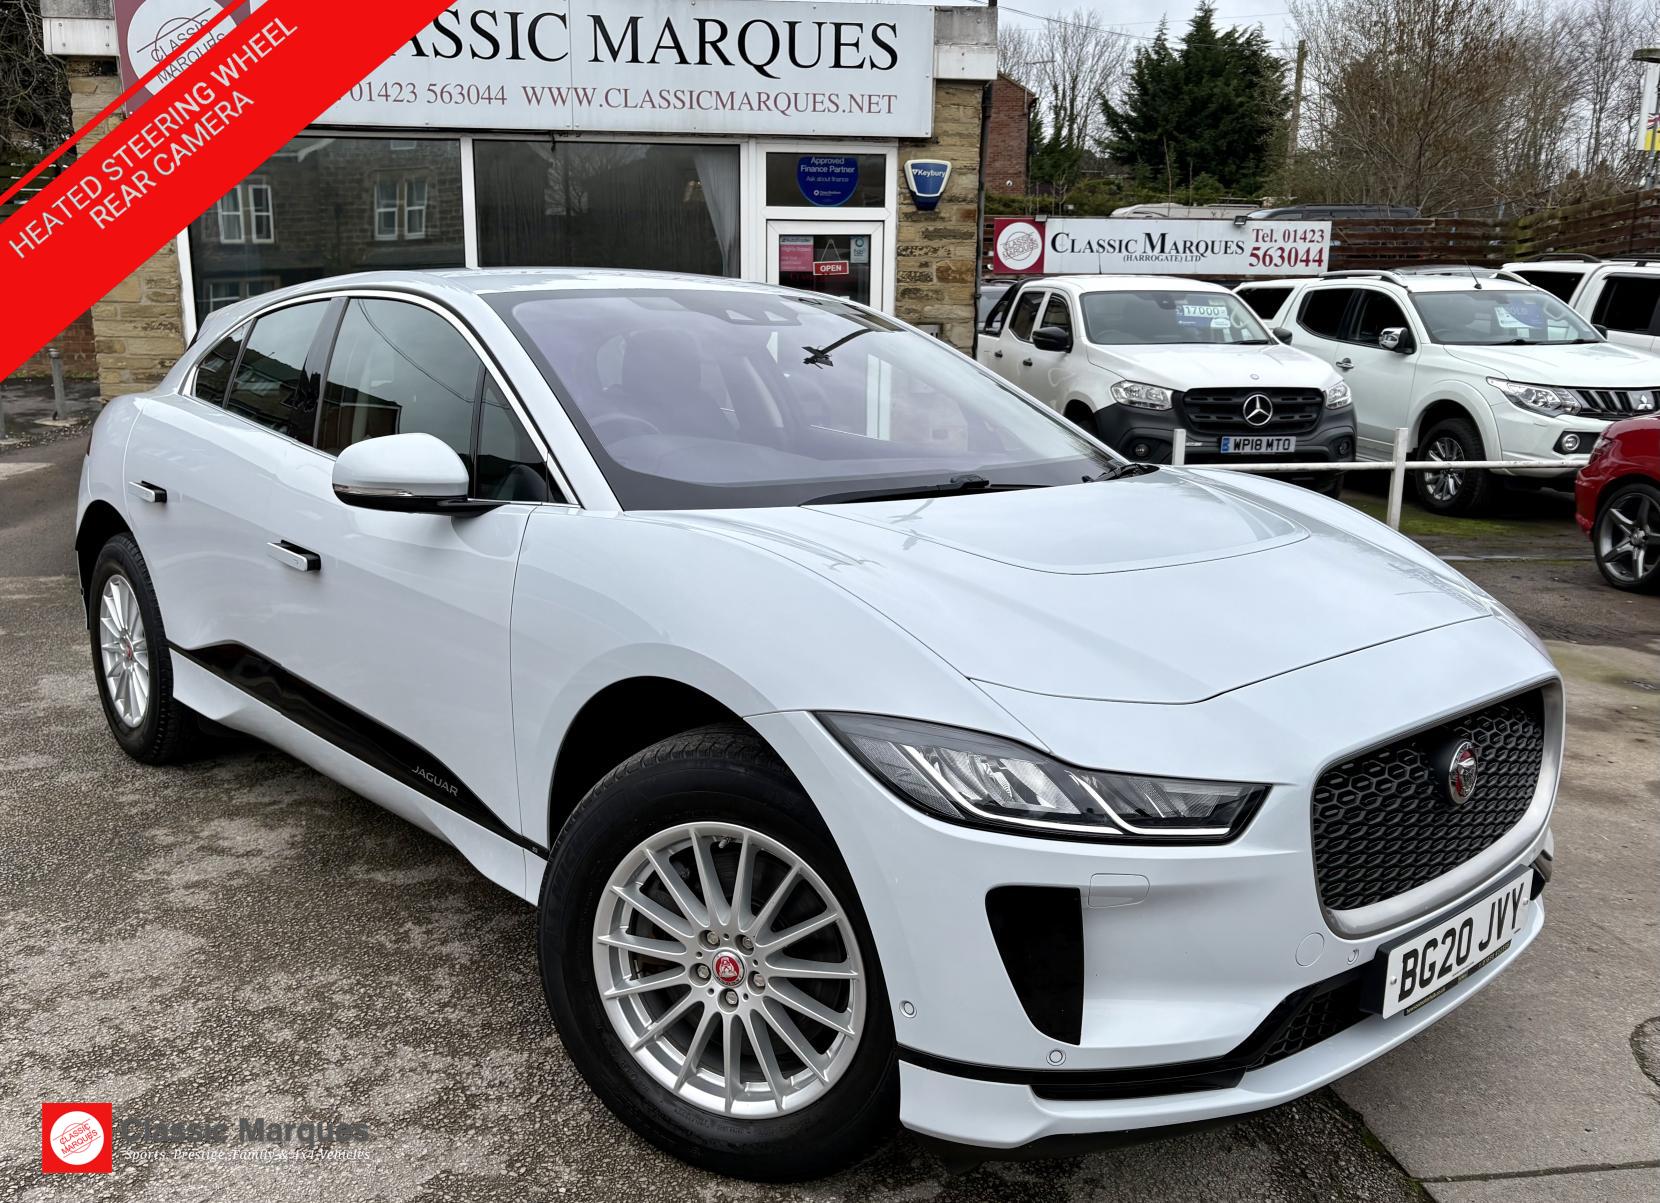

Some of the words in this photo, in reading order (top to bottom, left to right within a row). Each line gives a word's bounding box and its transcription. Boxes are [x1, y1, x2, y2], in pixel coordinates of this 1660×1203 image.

[587, 15, 898, 80] MARQUES
[350, 81, 418, 104] 01423
[426, 83, 508, 106] 563044
[521, 85, 898, 117] WWW.CLASSICMARQUES.NET
[811, 157, 845, 166] Approved
[801, 165, 828, 173] Finance
[829, 165, 855, 174] Partner
[918, 168, 946, 178] Keybury
[1252, 228, 1277, 243] Tel.
[1282, 228, 1325, 243] 01423
[1050, 232, 1138, 255] CLASSIC
[1142, 232, 1245, 258] MARQUES
[1123, 254, 1184, 262] (HARROGATE)
[1185, 254, 1202, 262] LTD
[1248, 246, 1325, 268] 563044
[820, 264, 842, 272] OPEN
[1233, 438, 1263, 451] WP18
[1265, 438, 1291, 451] MTO
[411, 766, 459, 797] JAGUAR
[1397, 916, 1474, 1003] BG20
[1478, 882, 1525, 952] JVY
